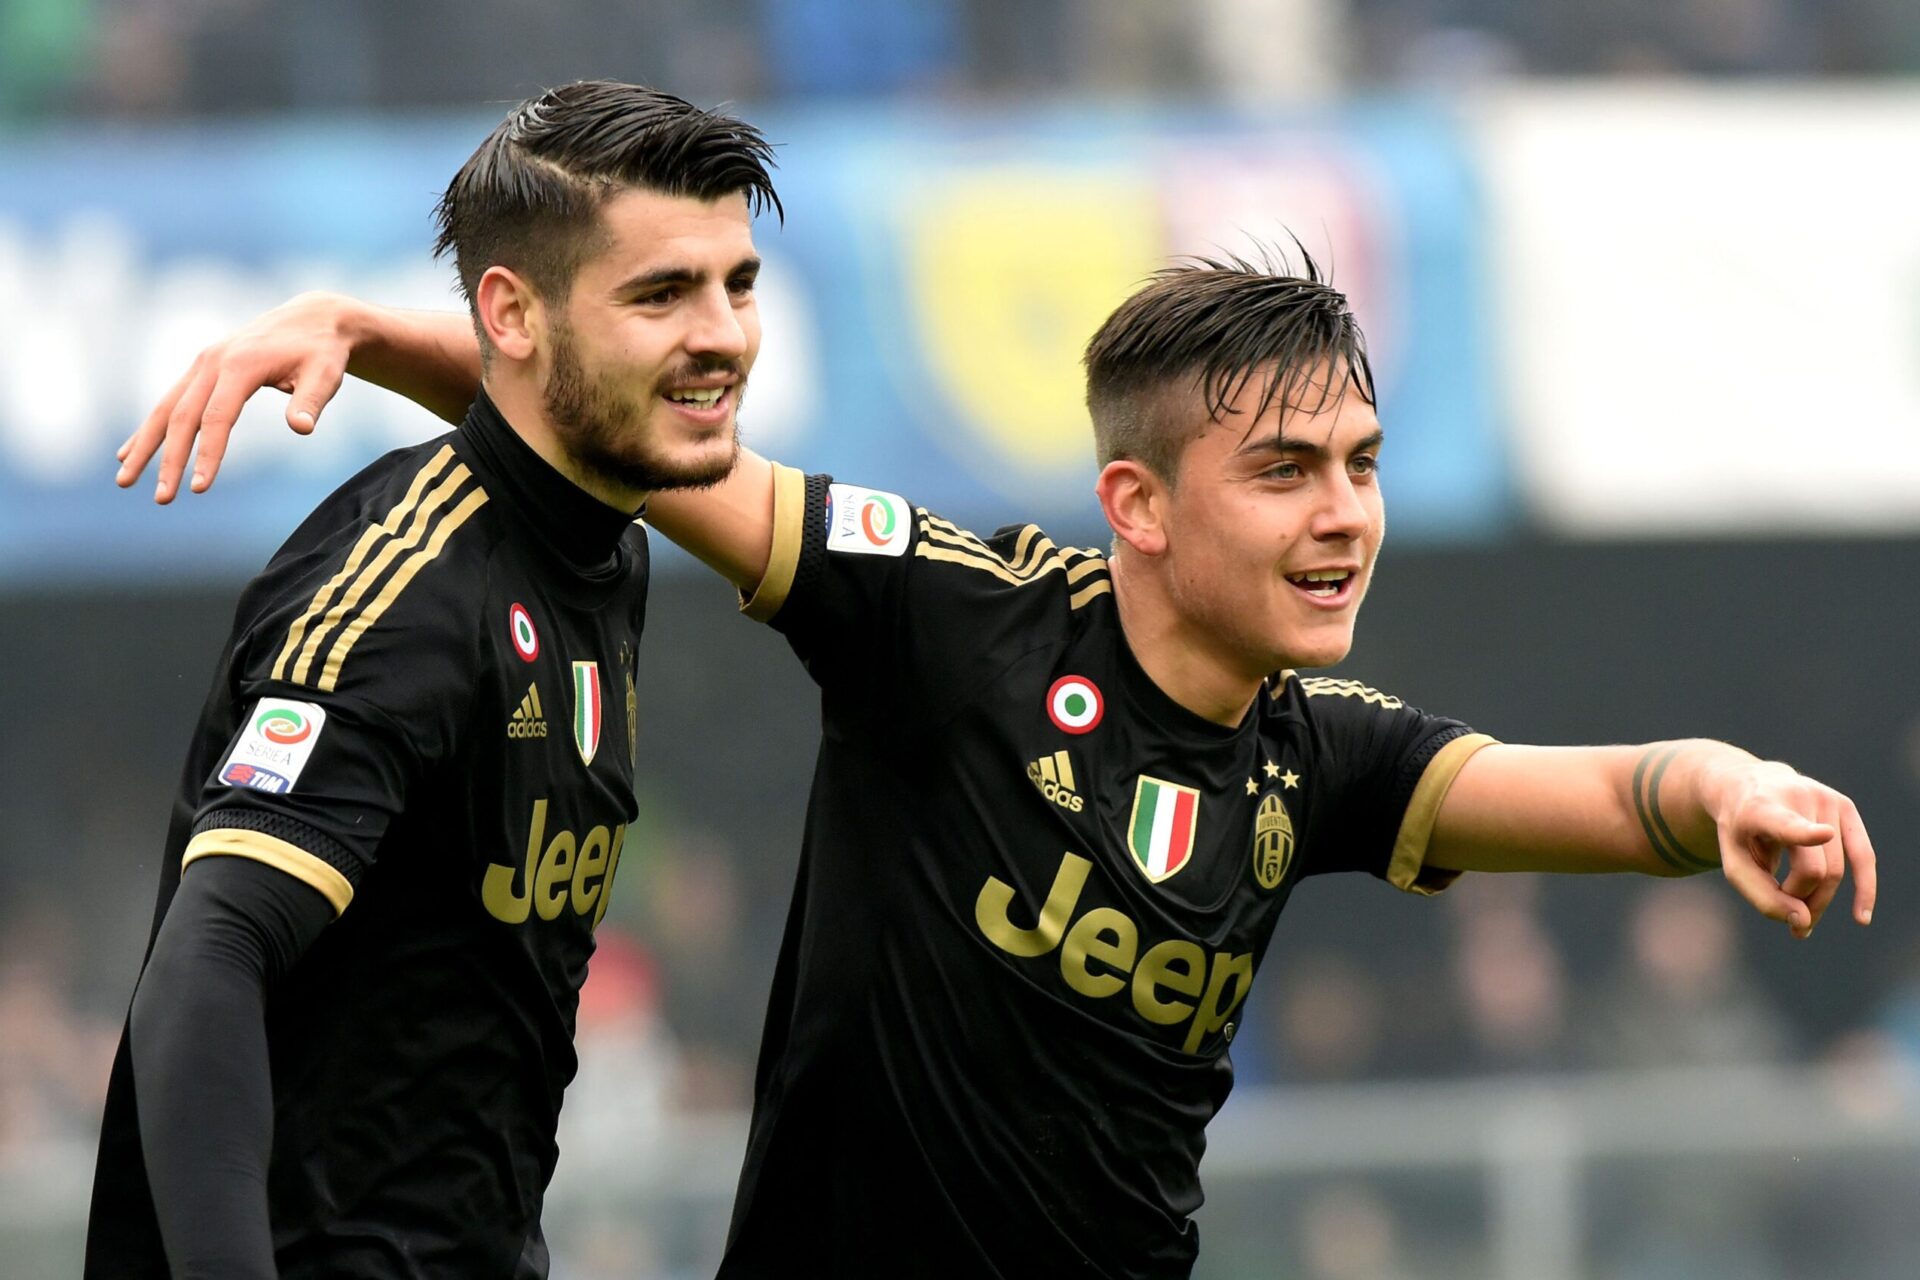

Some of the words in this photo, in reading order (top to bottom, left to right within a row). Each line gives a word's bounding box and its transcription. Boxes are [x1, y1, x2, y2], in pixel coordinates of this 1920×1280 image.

[507, 716, 547, 738] adidas
[246, 741, 281, 762] SERIE
[279, 752, 292, 766] A
[248, 771, 285, 793] TIM
[975, 851, 1253, 1055] Jeep
